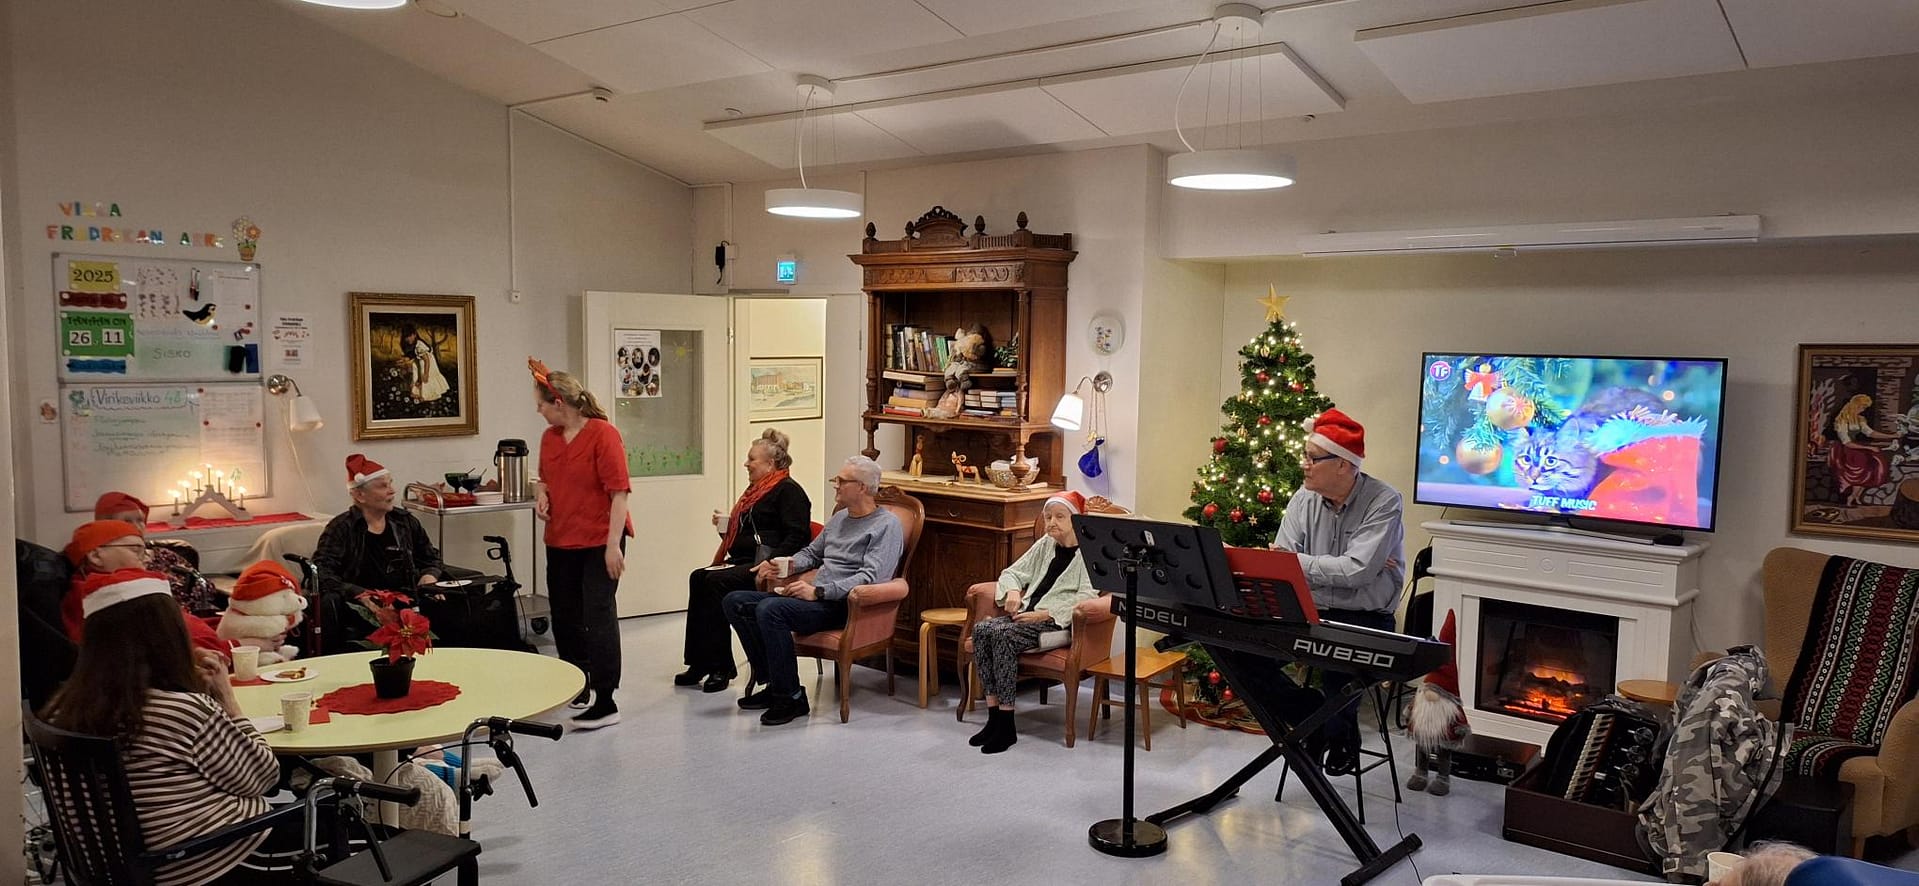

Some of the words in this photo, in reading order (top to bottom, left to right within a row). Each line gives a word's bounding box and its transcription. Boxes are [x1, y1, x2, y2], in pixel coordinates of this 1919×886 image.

[73, 269, 114, 283] 2025
[71, 332, 90, 345] 26
[104, 331, 123, 344] 11
[1531, 495, 1560, 507] TUFF
[1560, 498, 1597, 510] MUSIC
[1293, 638, 1395, 668] AW830
